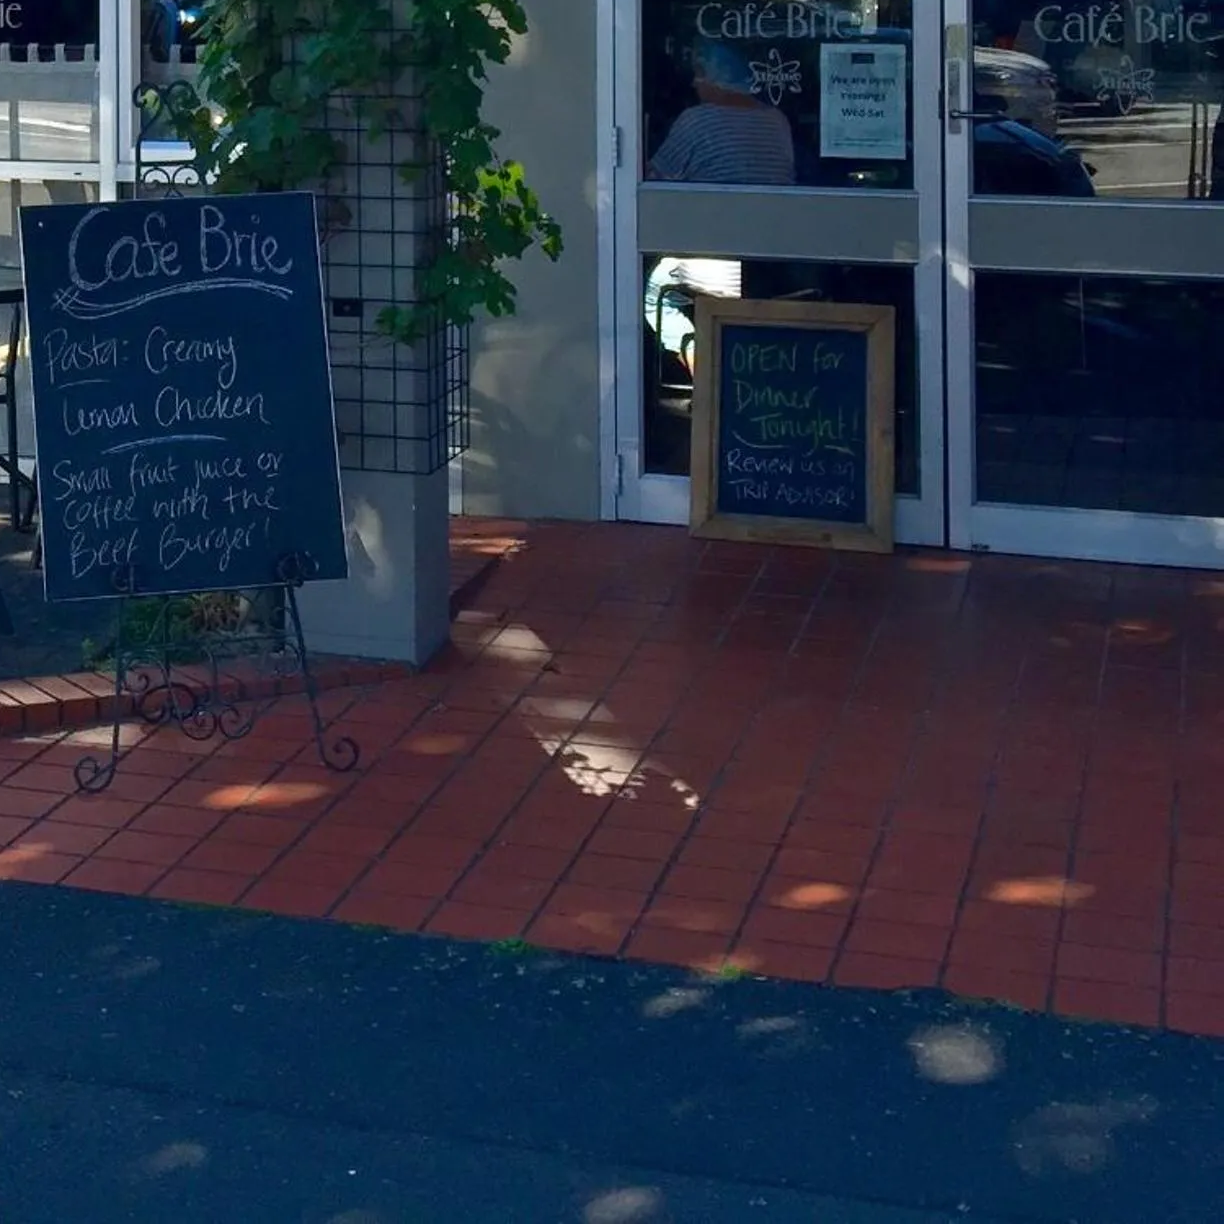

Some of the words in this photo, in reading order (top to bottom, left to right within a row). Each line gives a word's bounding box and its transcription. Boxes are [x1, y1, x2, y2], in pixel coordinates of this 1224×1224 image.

[696, 1, 776, 39] Café
[1033, 3, 1123, 44] Café
[1134, 4, 1210, 44] Brie
[200, 204, 293, 274] Brie
[144, 325, 238, 389] Creamy
[730, 341, 798, 376] OPEN
[154, 385, 272, 428] Chicken
[731, 379, 820, 415] Dinner
[52, 459, 112, 501] Small
[256, 451, 284, 474] or
[727, 447, 793, 475] Review
[800, 458, 826, 476] us
[152, 487, 210, 520] with
[222, 485, 280, 514] the
[69, 527, 139, 578] Beef
